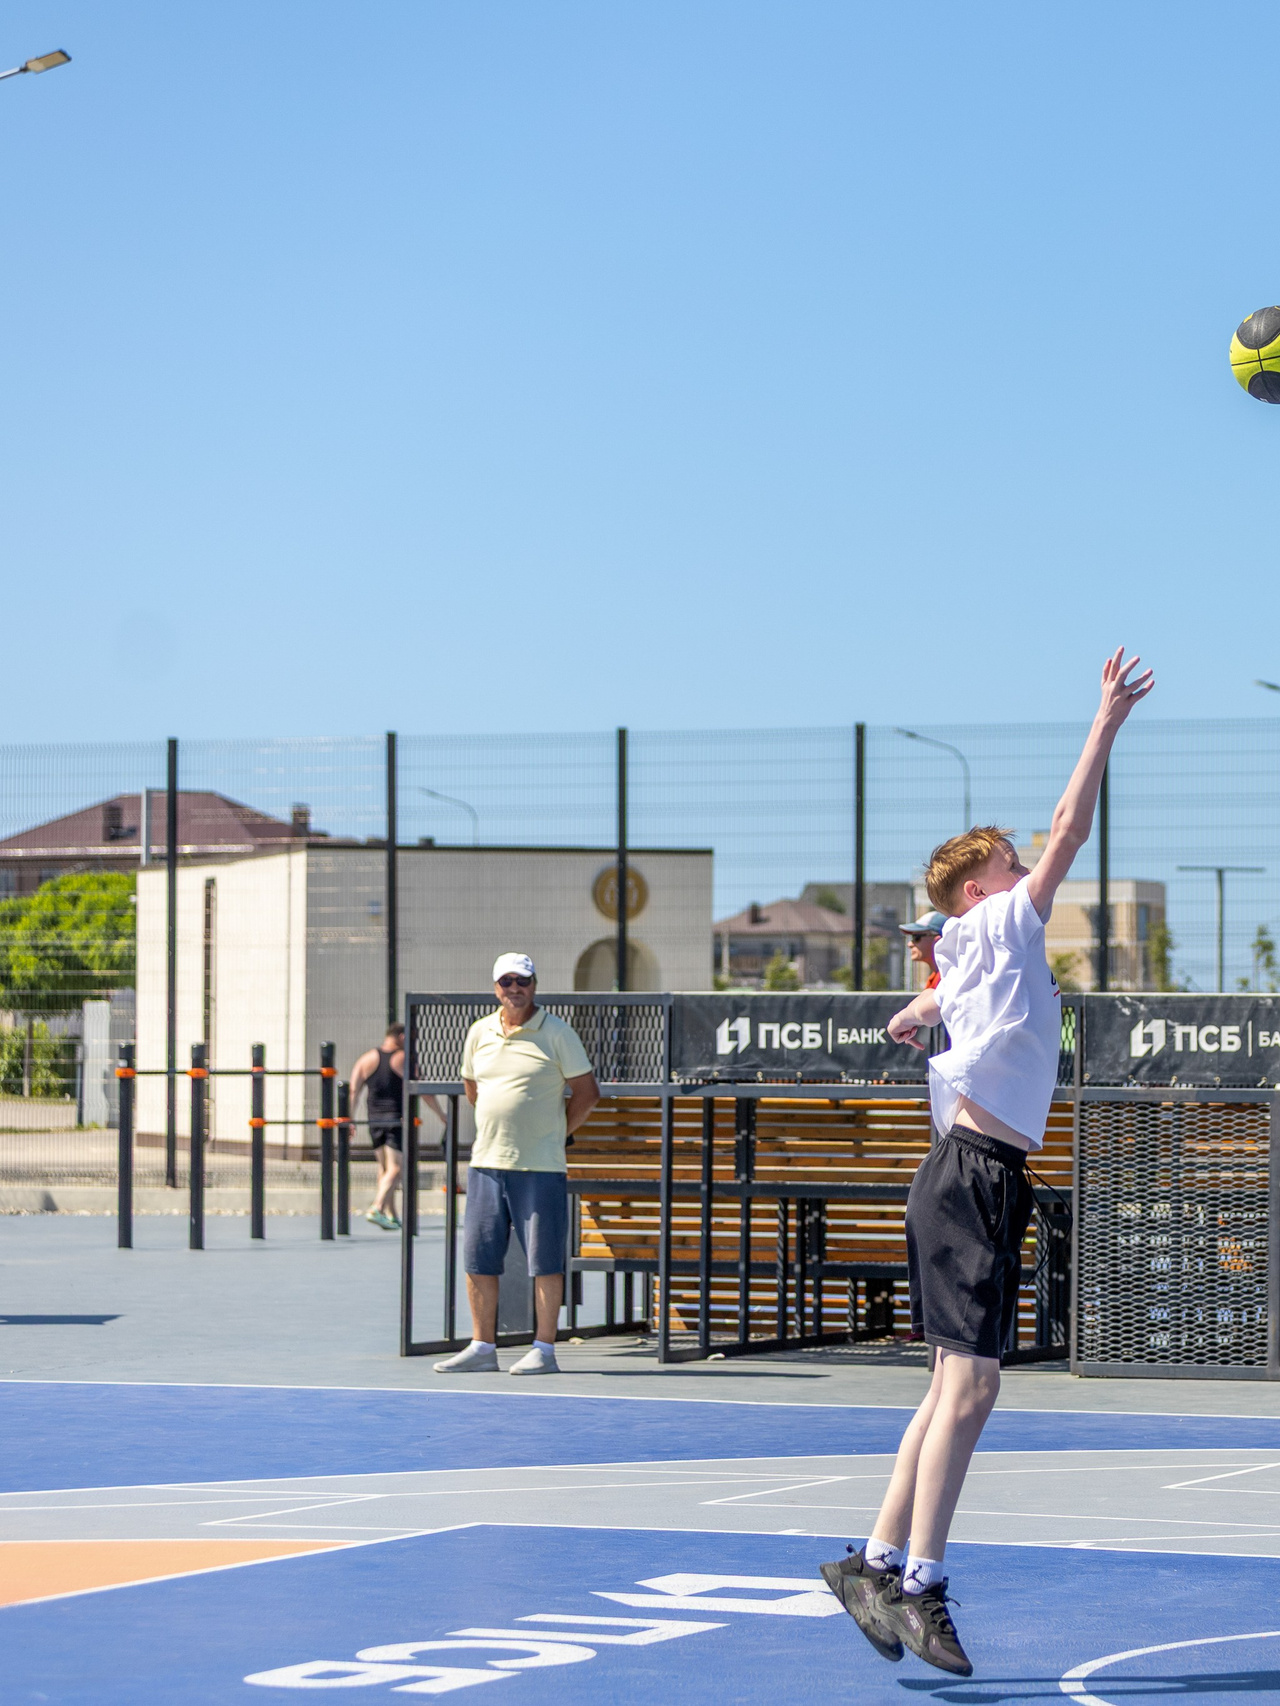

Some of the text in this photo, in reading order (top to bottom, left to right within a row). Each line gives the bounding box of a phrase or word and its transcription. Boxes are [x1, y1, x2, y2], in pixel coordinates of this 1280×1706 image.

[758, 1022, 887, 1050] ПСБ БАНК
[1174, 1025, 1241, 1053] ПСБ
[243, 1613, 730, 1694] ПСБ
